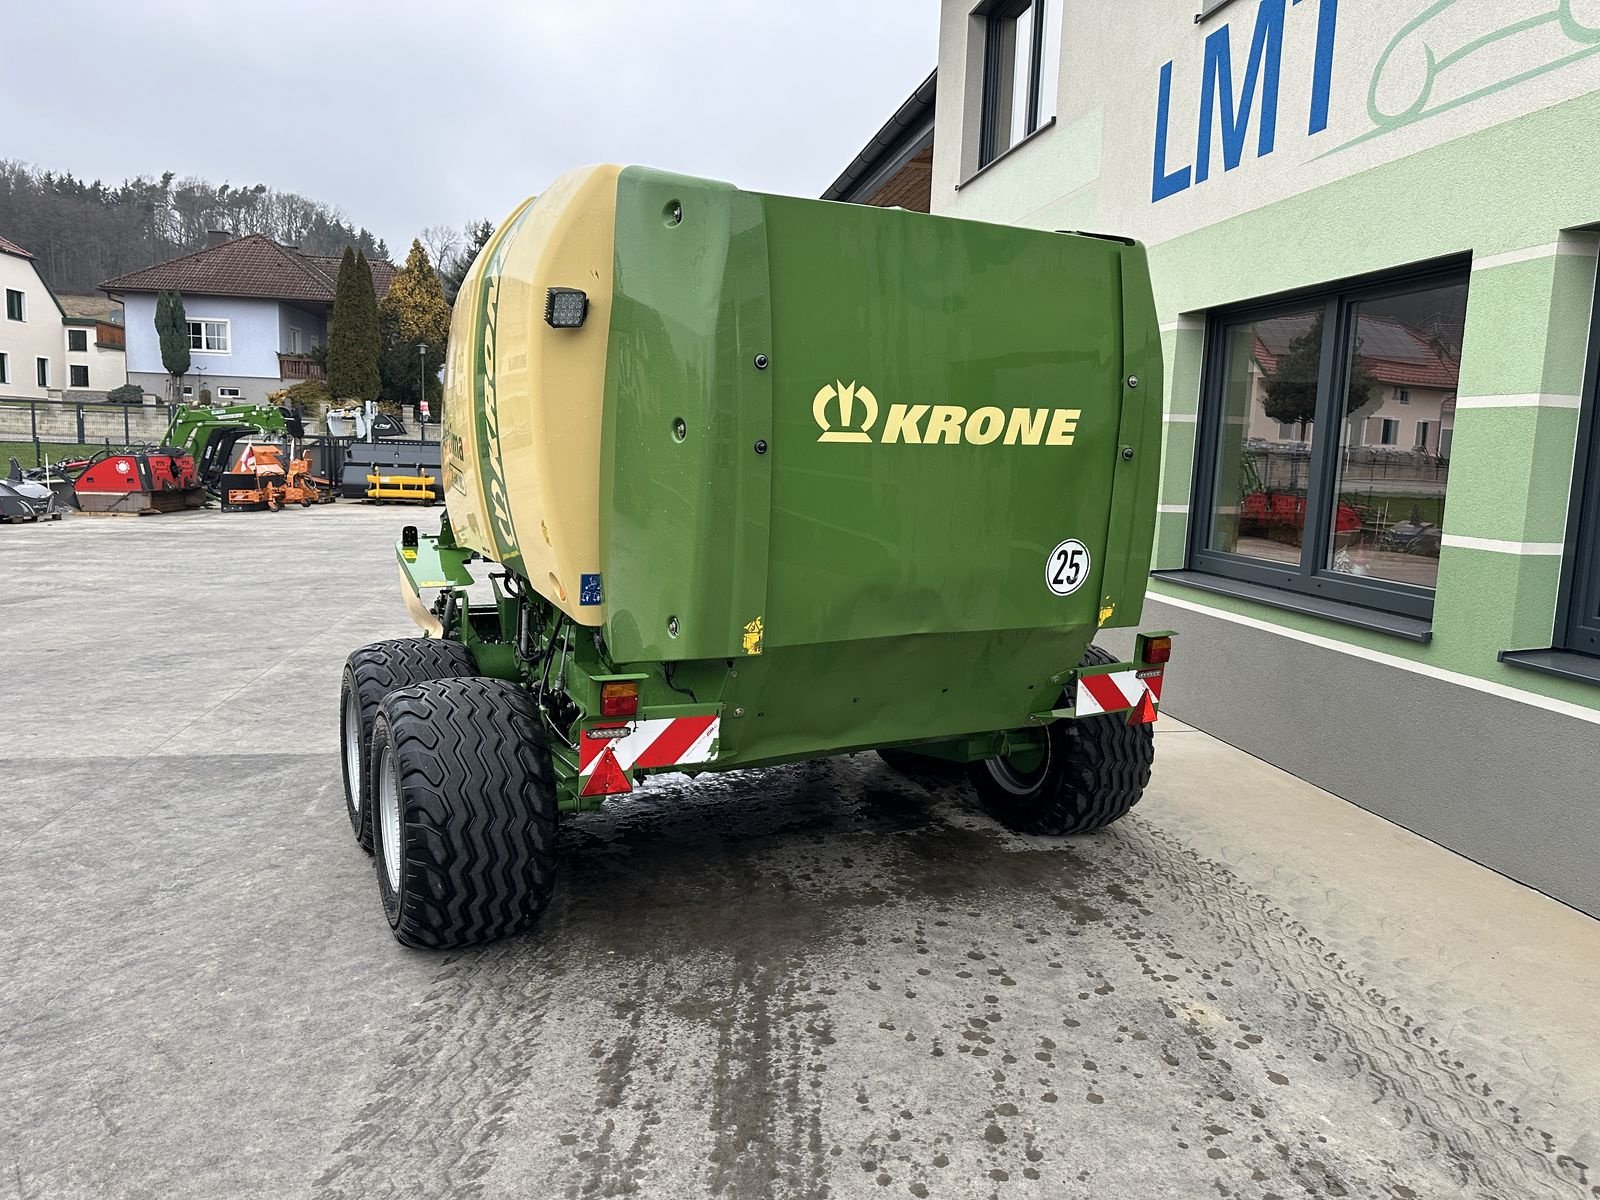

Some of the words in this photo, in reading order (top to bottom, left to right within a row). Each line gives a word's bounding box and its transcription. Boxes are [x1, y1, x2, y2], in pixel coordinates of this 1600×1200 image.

[1152, 0, 1338, 204] LMT
[881, 404, 1081, 446] KRONE
[1053, 549, 1083, 585] 25
